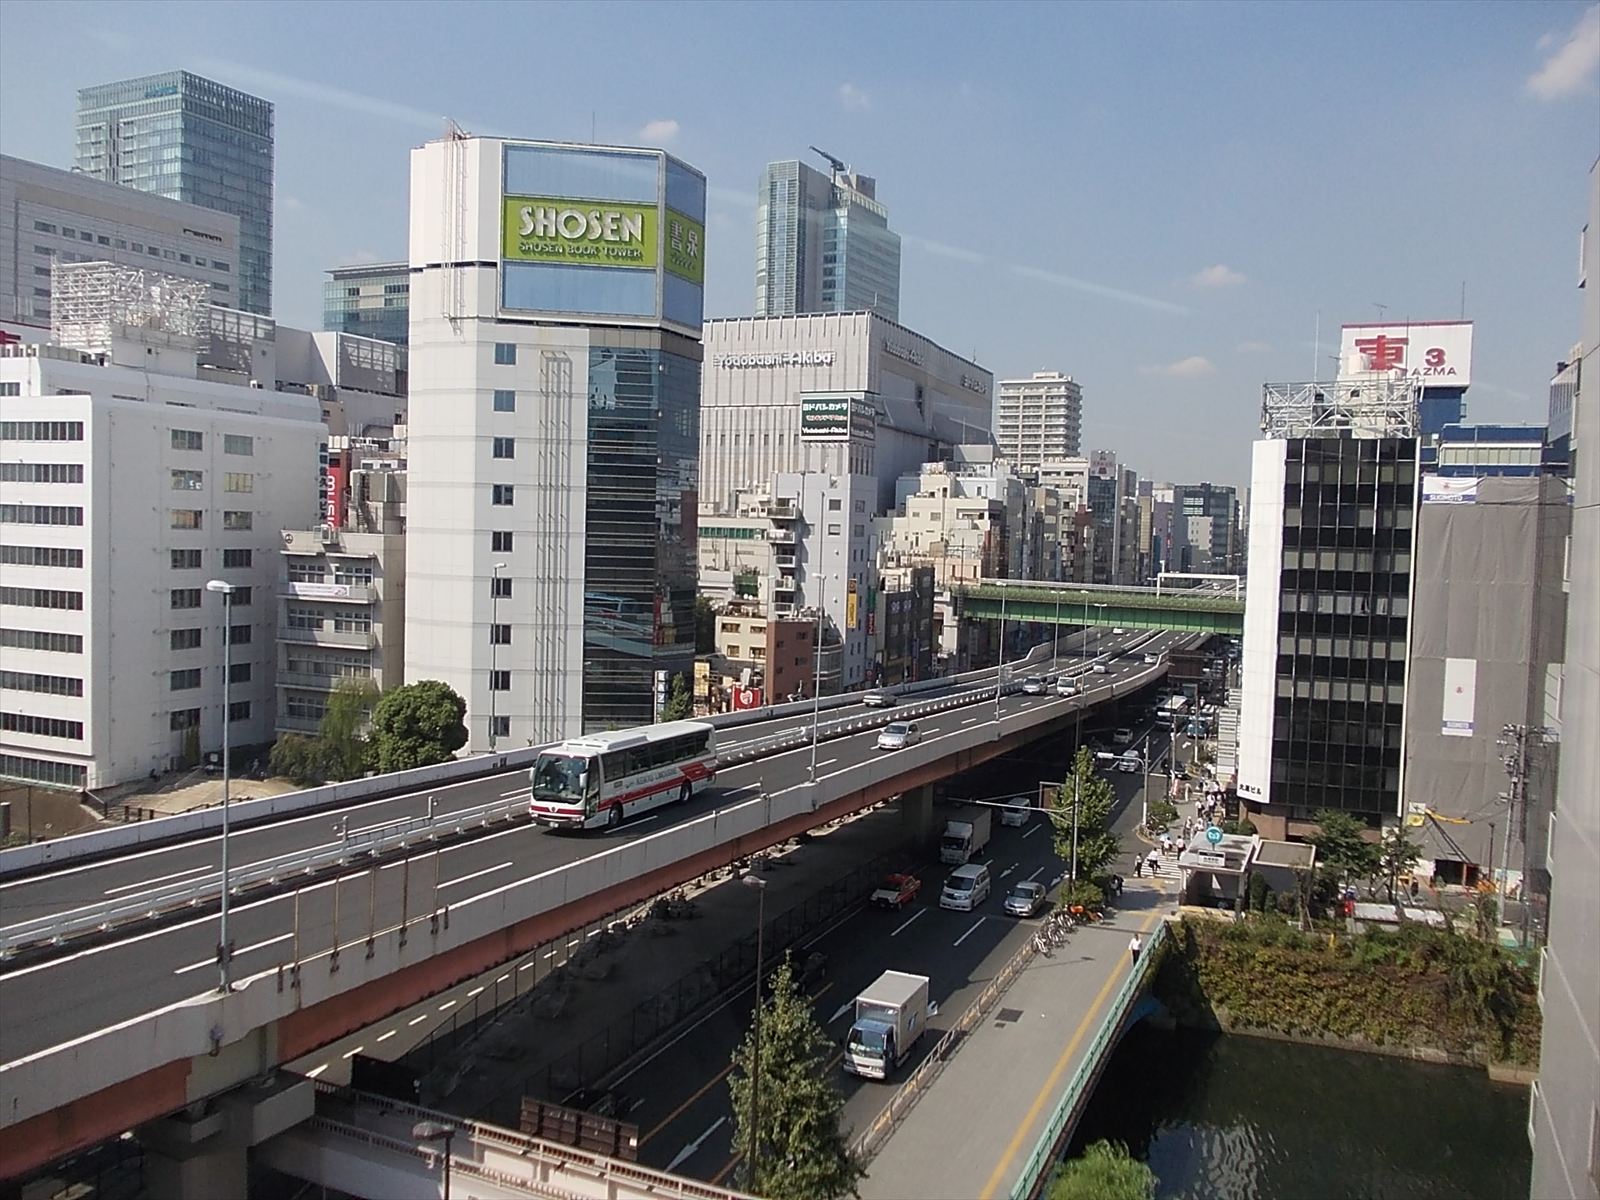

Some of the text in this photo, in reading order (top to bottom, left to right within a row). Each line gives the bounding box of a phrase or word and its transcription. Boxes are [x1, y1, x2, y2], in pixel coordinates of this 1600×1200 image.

[519, 206, 643, 242] SHOSEN
[519, 241, 642, 258] SHOSEN BOOK TOWER
[1425, 347, 1446, 367] 3
[1411, 366, 1458, 377] AZMA
